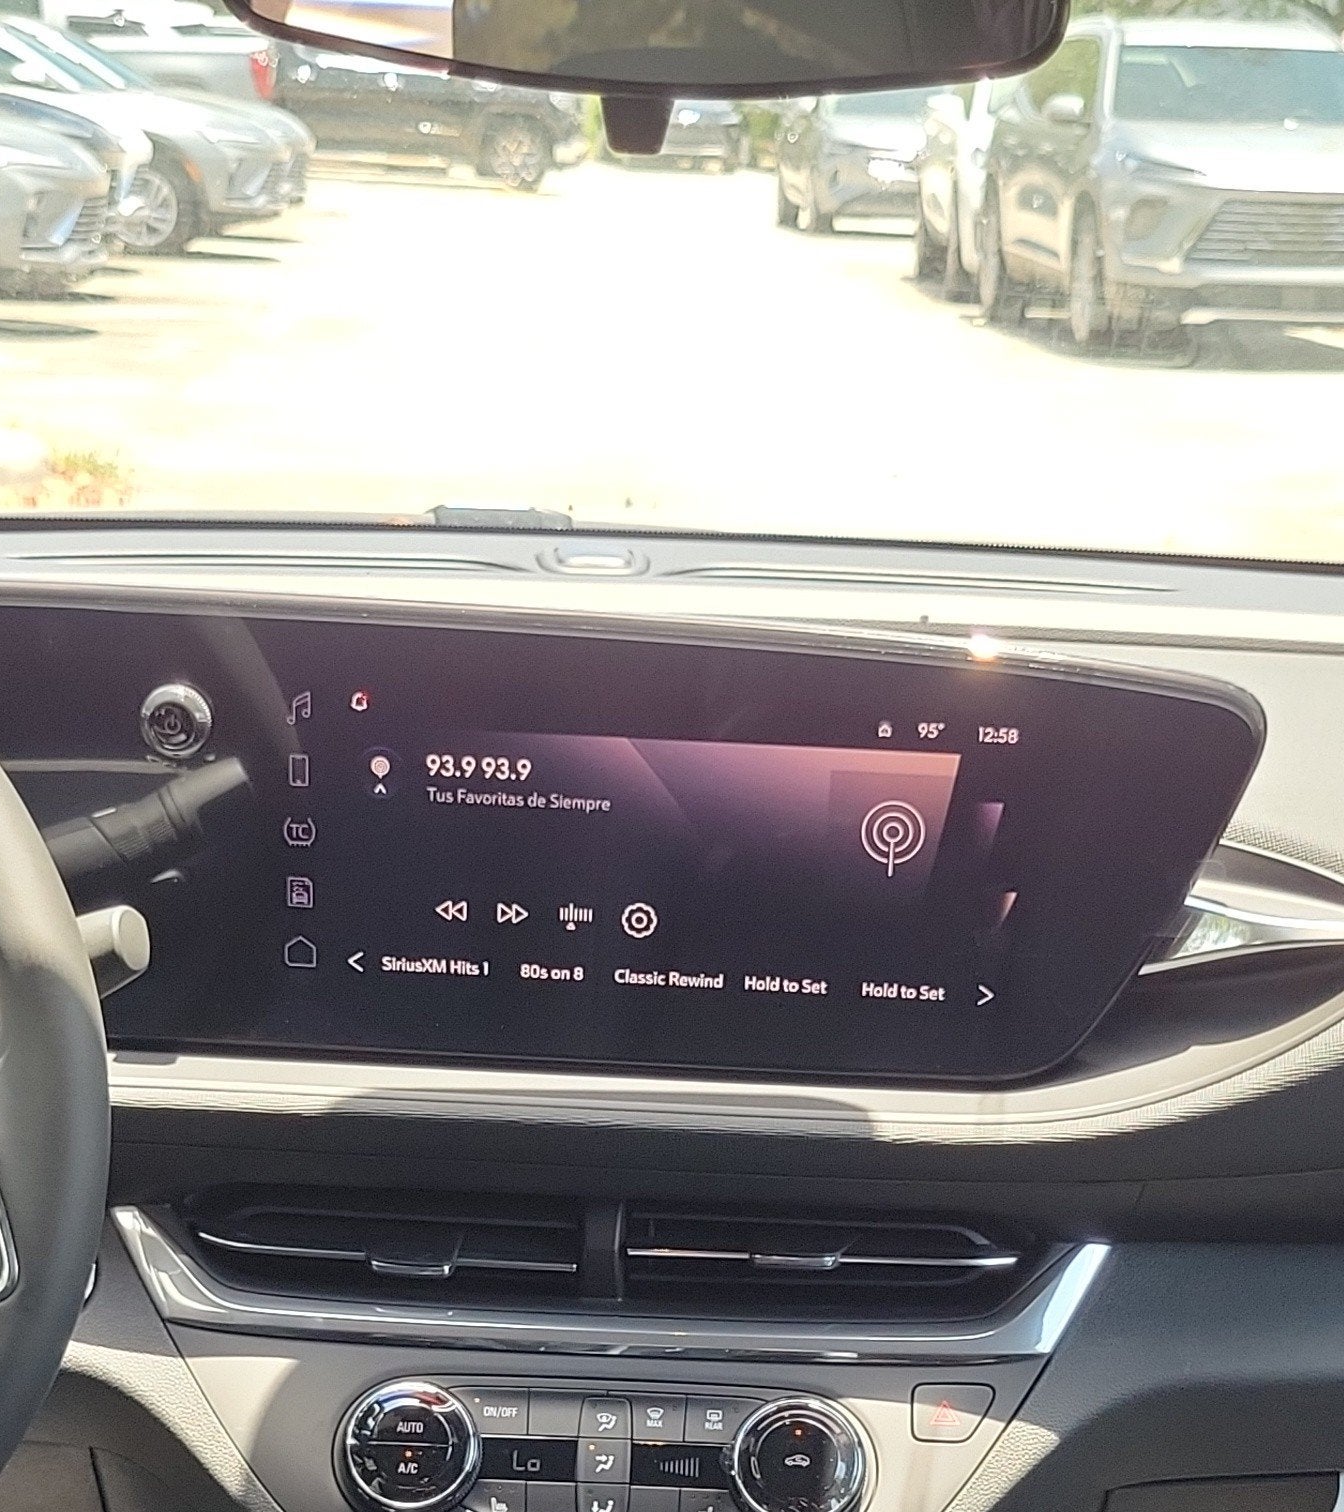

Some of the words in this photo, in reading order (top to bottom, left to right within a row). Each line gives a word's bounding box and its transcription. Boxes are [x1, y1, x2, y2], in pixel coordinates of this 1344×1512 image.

[978, 726, 1019, 744] 12:58
[425, 754, 477, 778] 93.9
[481, 757, 532, 781] 93.9
[426, 787, 454, 804] Tus
[457, 789, 524, 808] Favoritas
[527, 792, 546, 808] de
[550, 795, 611, 814] Siempre
[381, 956, 447, 974] SiriusXM
[449, 959, 479, 976] Hits
[482, 961, 490, 976] 1
[520, 963, 548, 980] 80s
[551, 968, 570, 980] on
[573, 966, 584, 981] 8
[613, 969, 666, 987] Classic
[668, 971, 724, 989] Rewind
[744, 975, 780, 992] Hold
[783, 978, 799, 993] to
[801, 979, 828, 995] Set
[861, 982, 897, 999] Hold
[900, 985, 916, 1000] to
[919, 986, 945, 1002] Set
[483, 1405, 518, 1418] ON/OFF
[396, 1421, 424, 1433] AUTO
[646, 1417, 663, 1429] MAX
[704, 1419, 723, 1431] REAR
[397, 1463, 419, 1475] A/C
